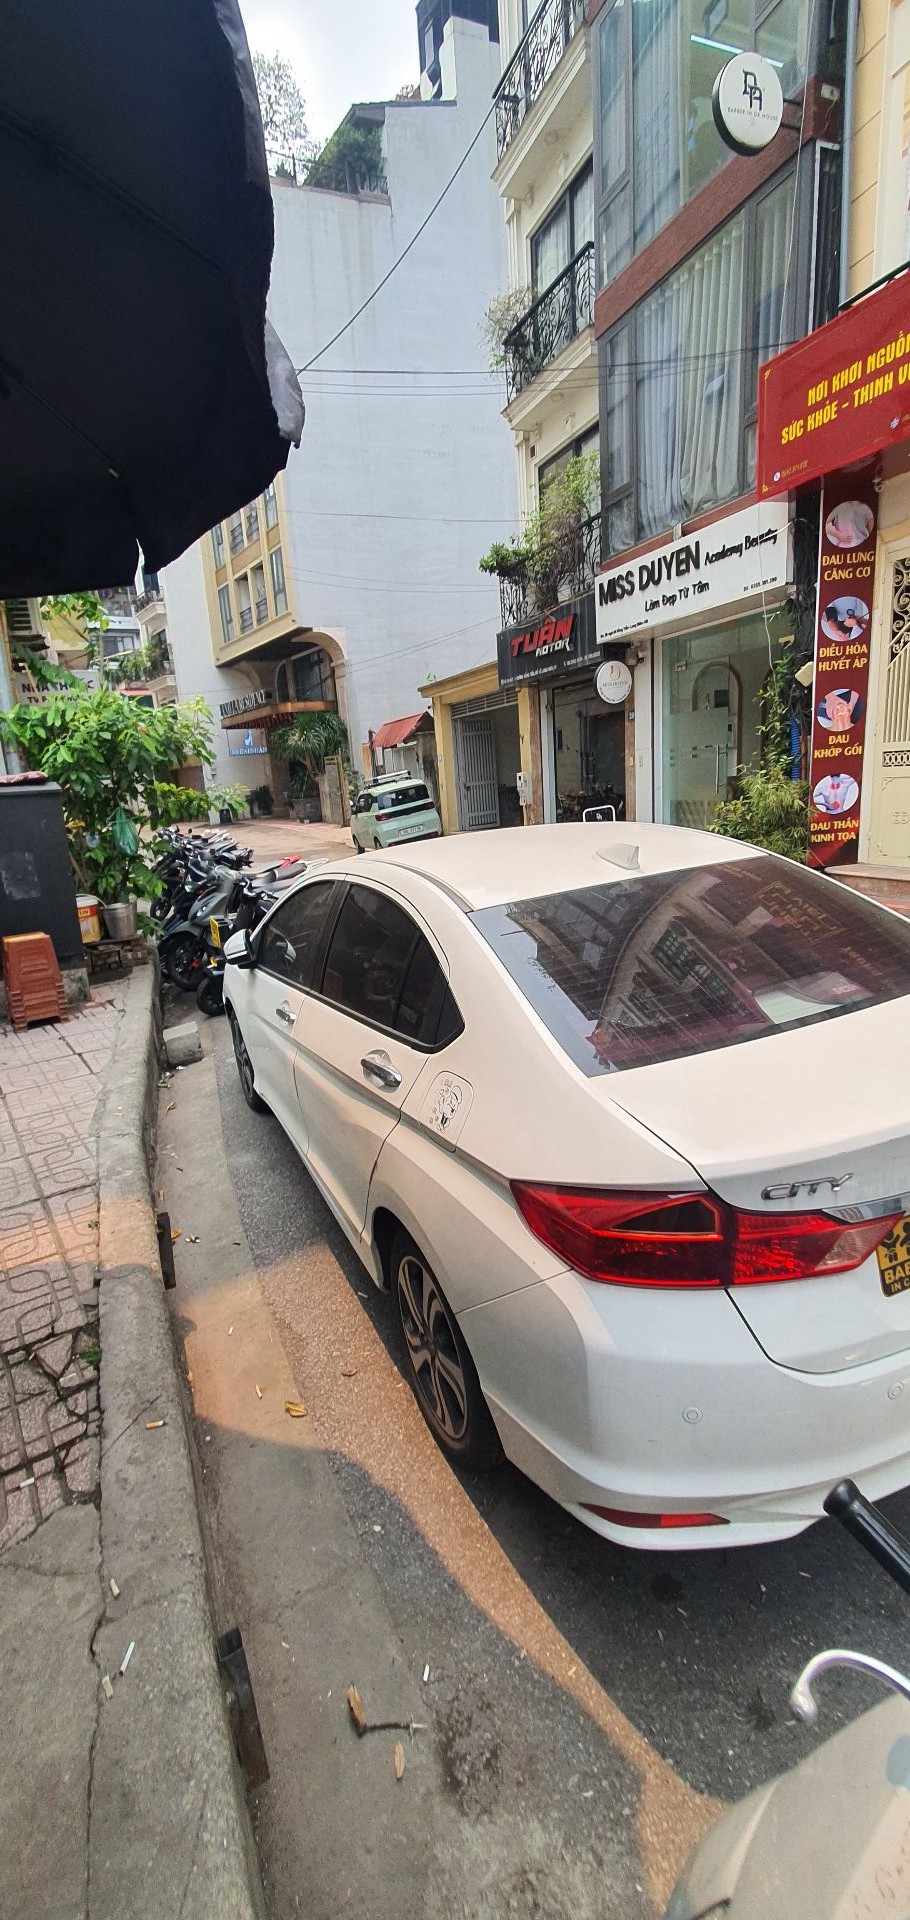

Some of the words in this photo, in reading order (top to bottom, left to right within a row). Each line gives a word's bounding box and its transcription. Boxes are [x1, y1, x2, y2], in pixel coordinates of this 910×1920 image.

[727, 107, 746, 115] BARBER
[807, 380, 828, 407] NƠI
[781, 420, 804, 445] SỨC
[806, 400, 838, 432] KHỎE
[853, 371, 894, 408] THỊNH
[598, 570, 635, 607] MISS
[638, 541, 700, 591] DUYEN
[704, 543, 743, 566] Academy
[744, 528, 778, 550] Beauty
[822, 553, 844, 566] ĐAU
[824, 568, 853, 581] CĂNG
[856, 566, 871, 578] CƠ
[644, 600, 660, 612] Làm
[662, 594, 677, 607] Đẹp
[692, 580, 710, 596] Tâm
[819, 642, 843, 658] ĐIỀU
[845, 641, 868, 655] HÒA
[818, 655, 851, 671] HUYẾT
[852, 655, 868, 668] ÁP
[828, 734, 850, 745] ĐAU
[813, 745, 843, 758] KHỚP
[844, 742, 863, 756] GỐI
[810, 821, 831, 831] ĐAU
[833, 816, 859, 829] THẦN
[811, 833, 835, 842] KINH
[837, 831, 857, 842] TỌA
[761, 1172, 854, 1201] CITY
[891, 1281, 902, 1292] IN
